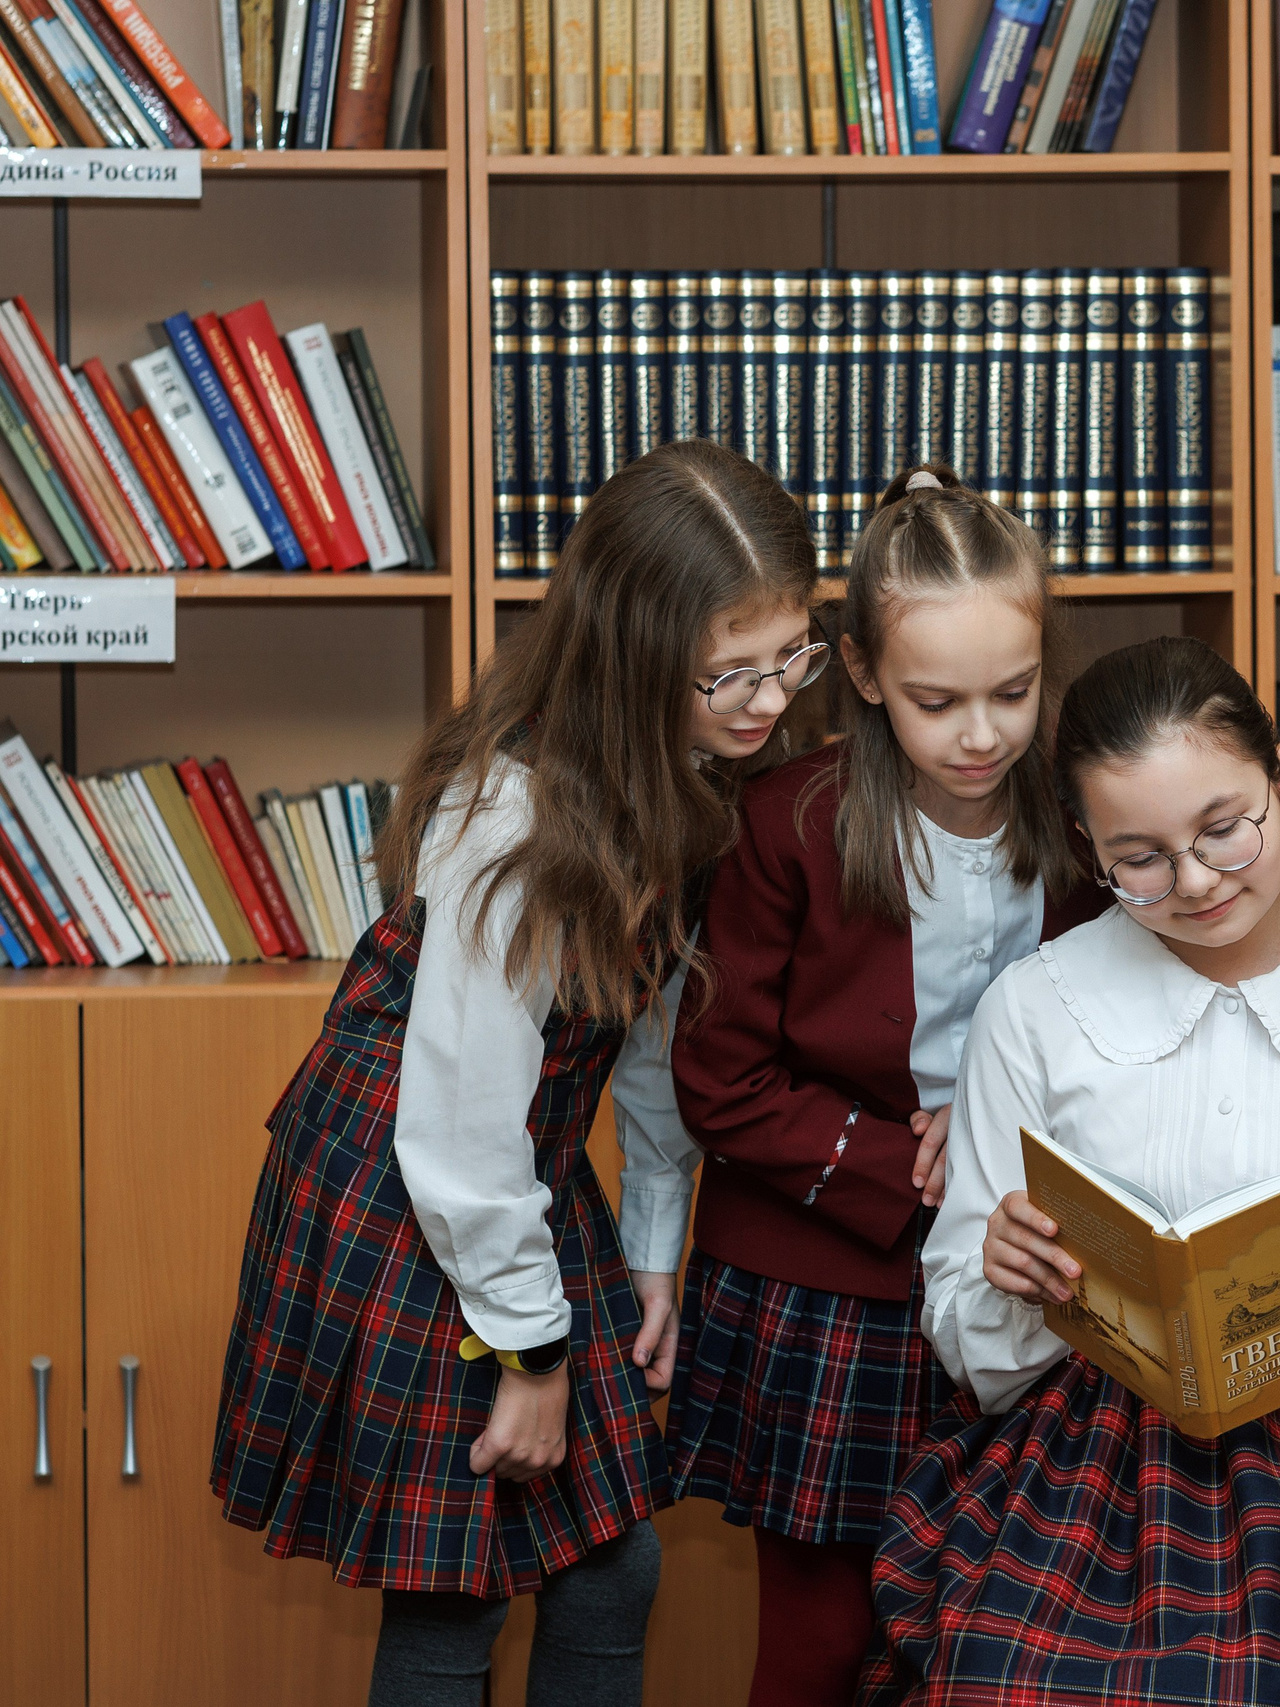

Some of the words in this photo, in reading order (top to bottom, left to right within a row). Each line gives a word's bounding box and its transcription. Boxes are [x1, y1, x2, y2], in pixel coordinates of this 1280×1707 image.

[88, 160, 178, 181] Россия
[500, 514, 510, 532] 1
[537, 514, 548, 532] 2
[1058, 510, 1078, 528] 17
[1091, 510, 1112, 528] 18
[6, 591, 83, 615] Тверь
[86, 625, 149, 651] край
[1174, 1317, 1186, 1354] ЗАПИСКАХ
[1180, 1365, 1200, 1407] ТВЕРЬ
[1226, 1378, 1237, 1390] В
